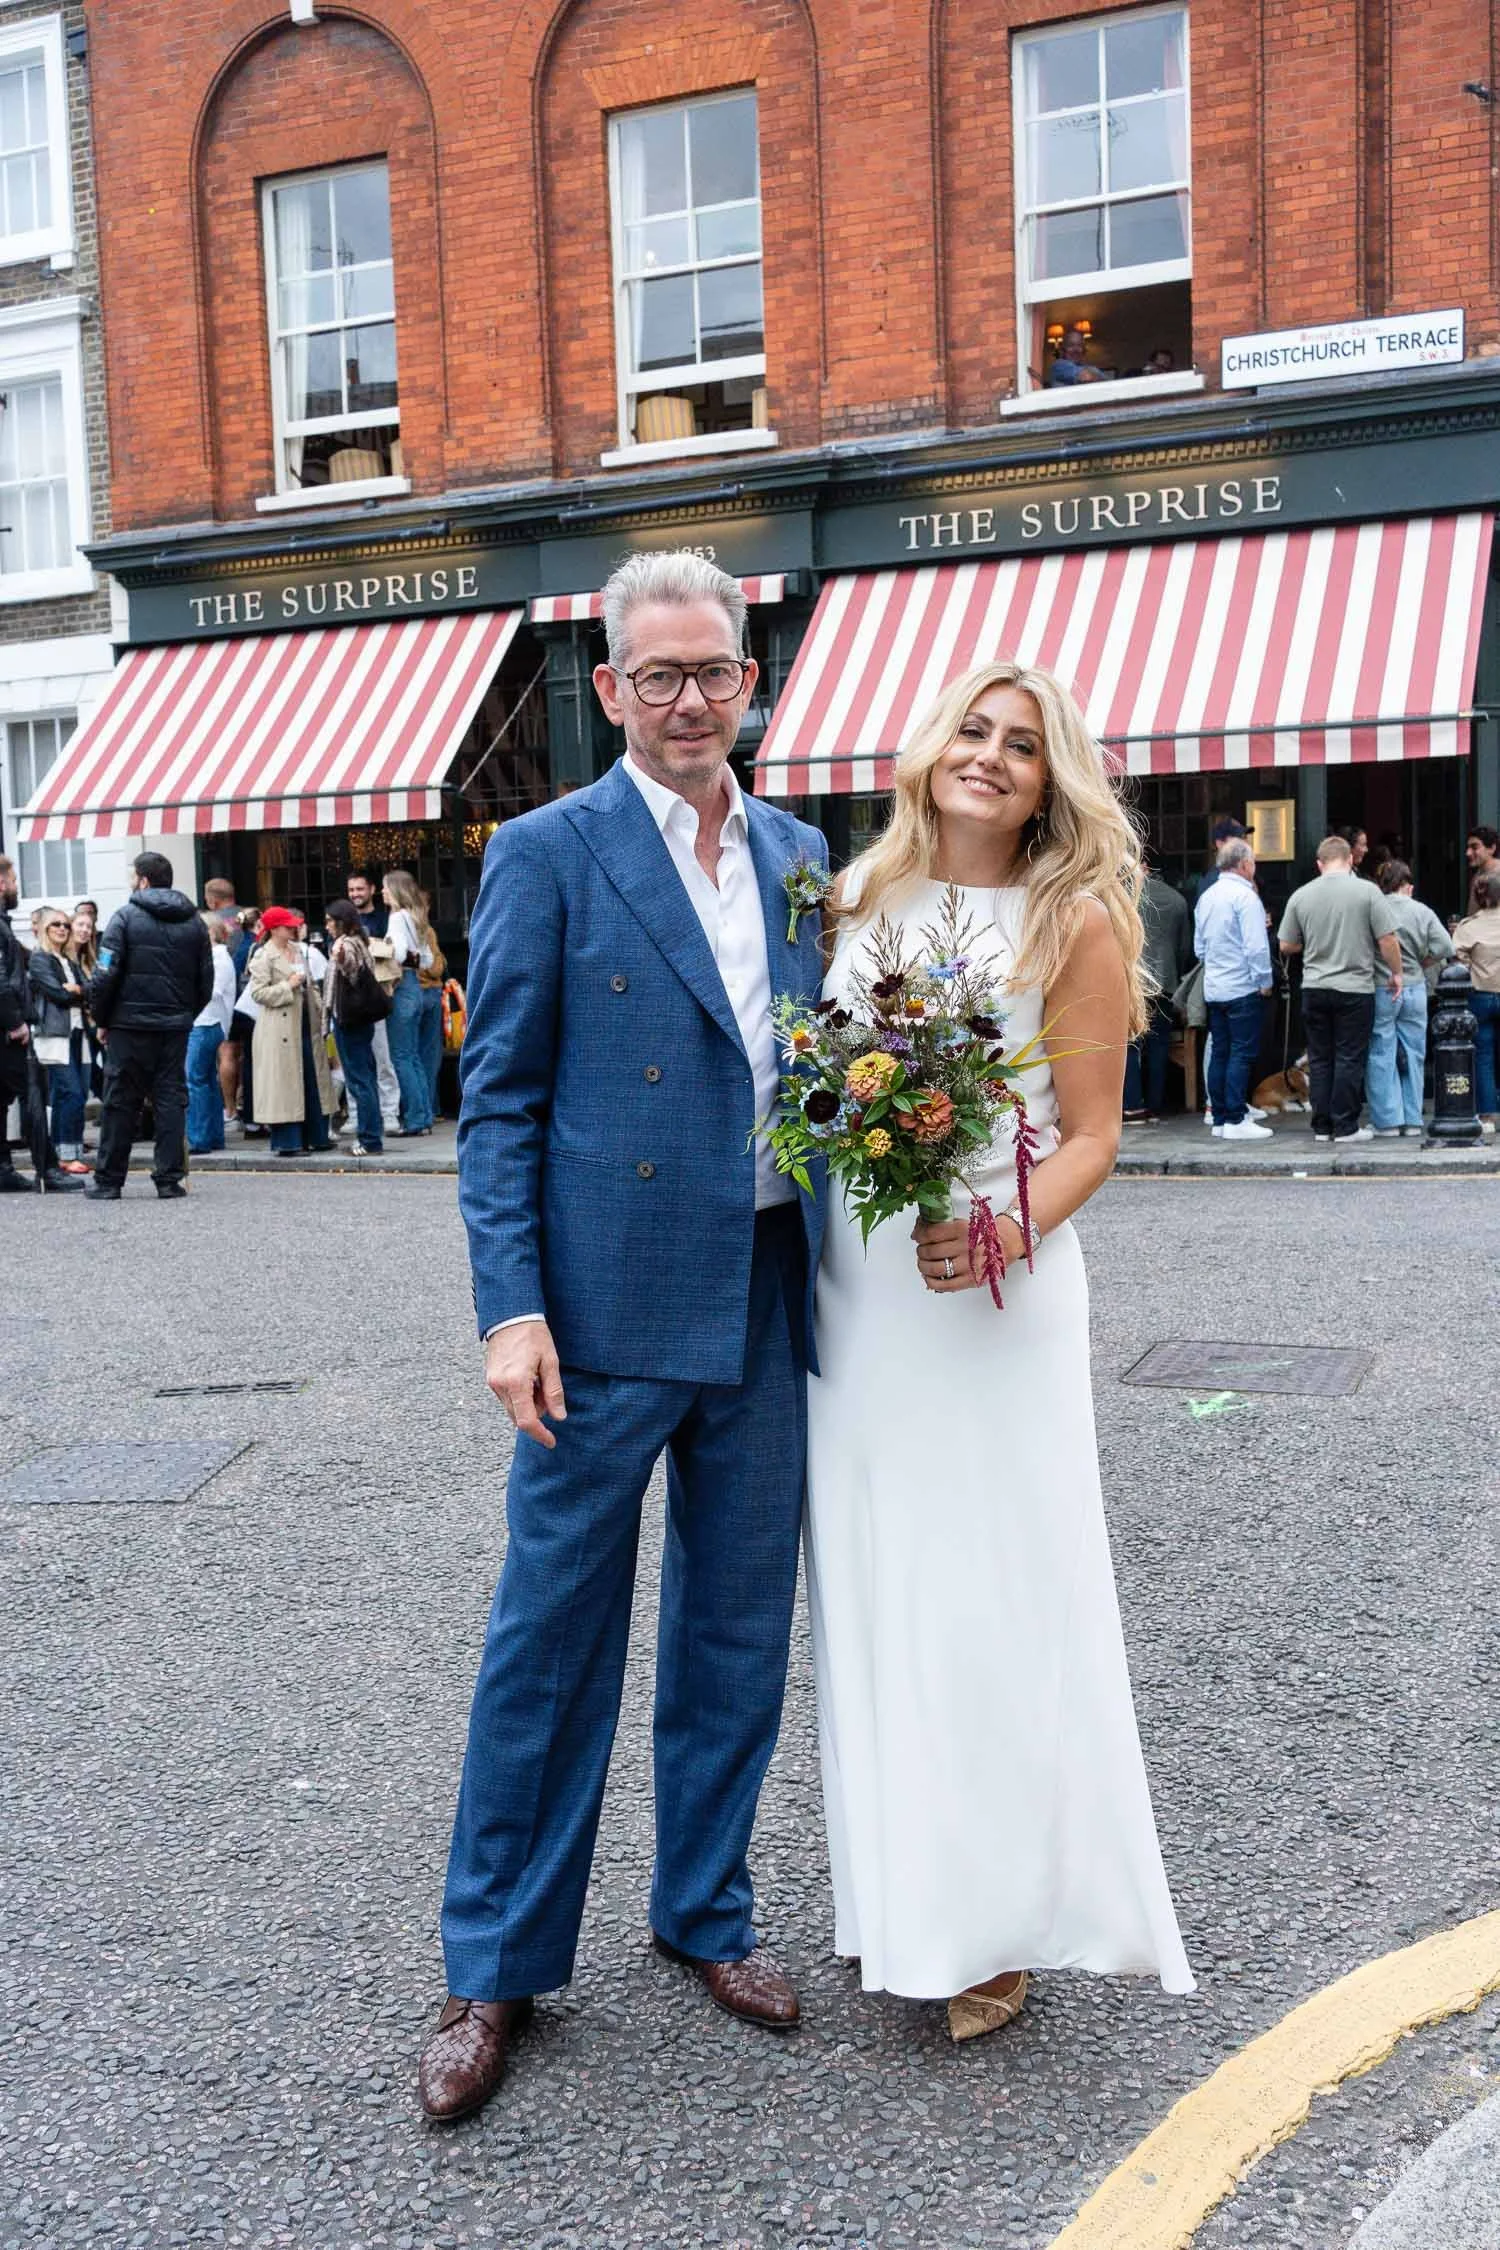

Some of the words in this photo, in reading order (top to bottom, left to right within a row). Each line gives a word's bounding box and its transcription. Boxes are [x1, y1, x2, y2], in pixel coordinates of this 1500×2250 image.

[1226, 338, 1366, 372] CHRISTCHURCH
[1376, 327, 1458, 353] TERRACE
[899, 508, 998, 550] THE
[1020, 476, 1283, 539] SURPRISE
[189, 591, 265, 627] THE
[282, 566, 480, 618] SURPRISE
